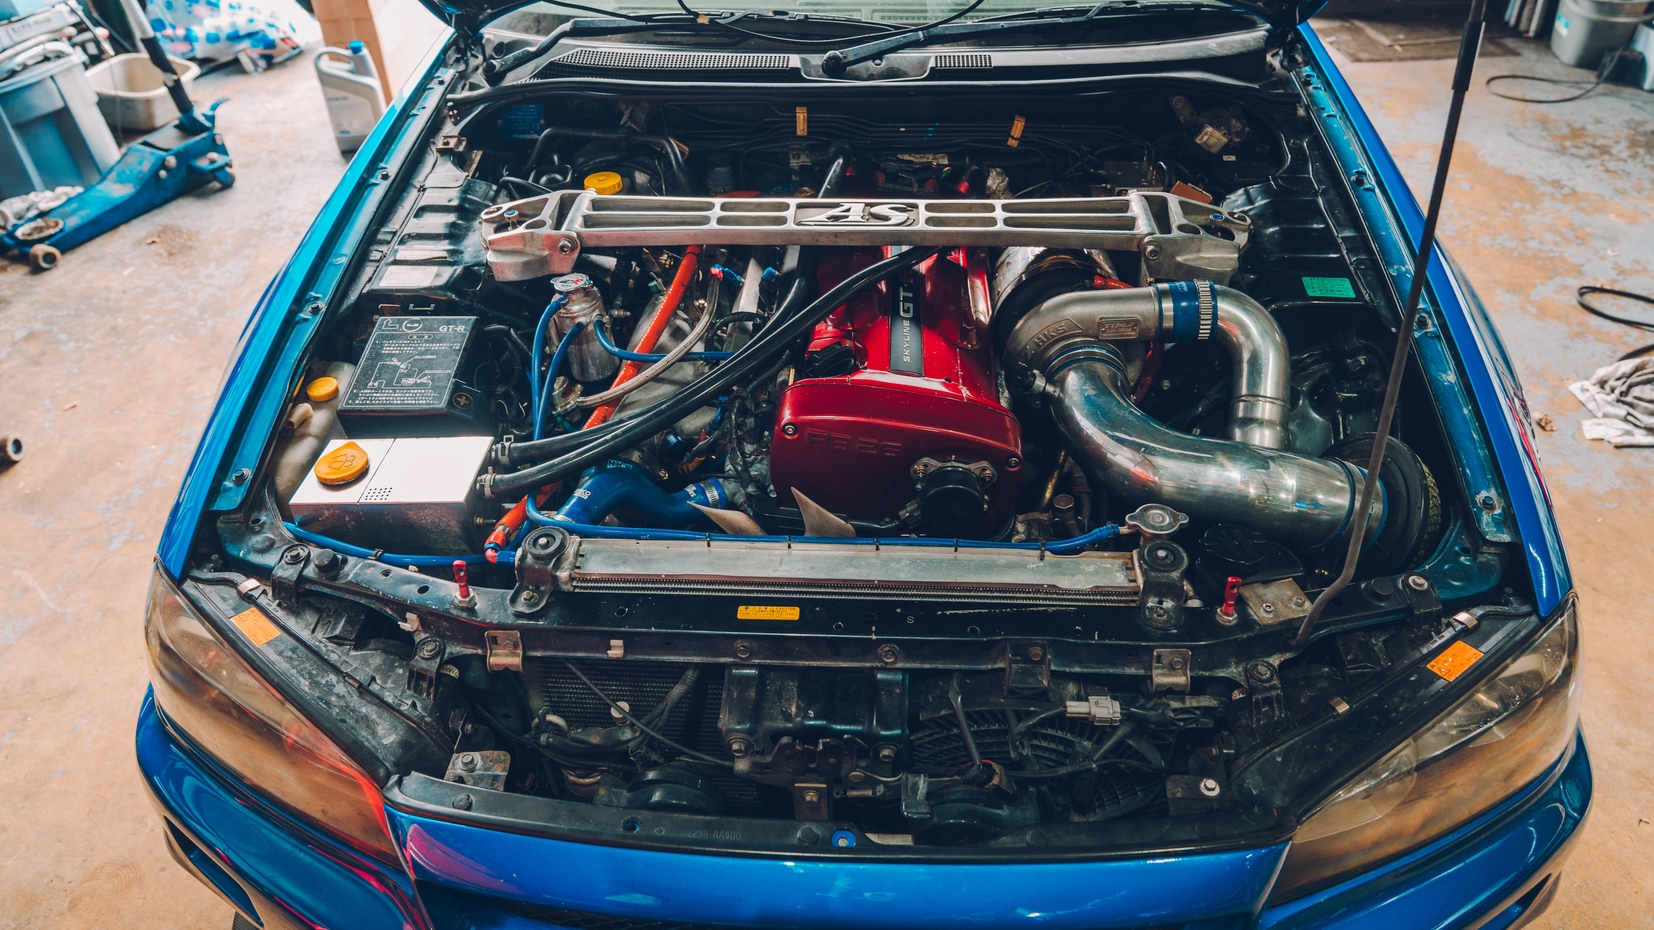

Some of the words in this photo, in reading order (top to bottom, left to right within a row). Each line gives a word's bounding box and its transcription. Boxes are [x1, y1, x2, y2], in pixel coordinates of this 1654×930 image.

[797, 202, 915, 226] AS
[902, 319, 910, 363] SKYLINE
[1034, 323, 1067, 347] HKS
[906, 615, 915, 624] S
